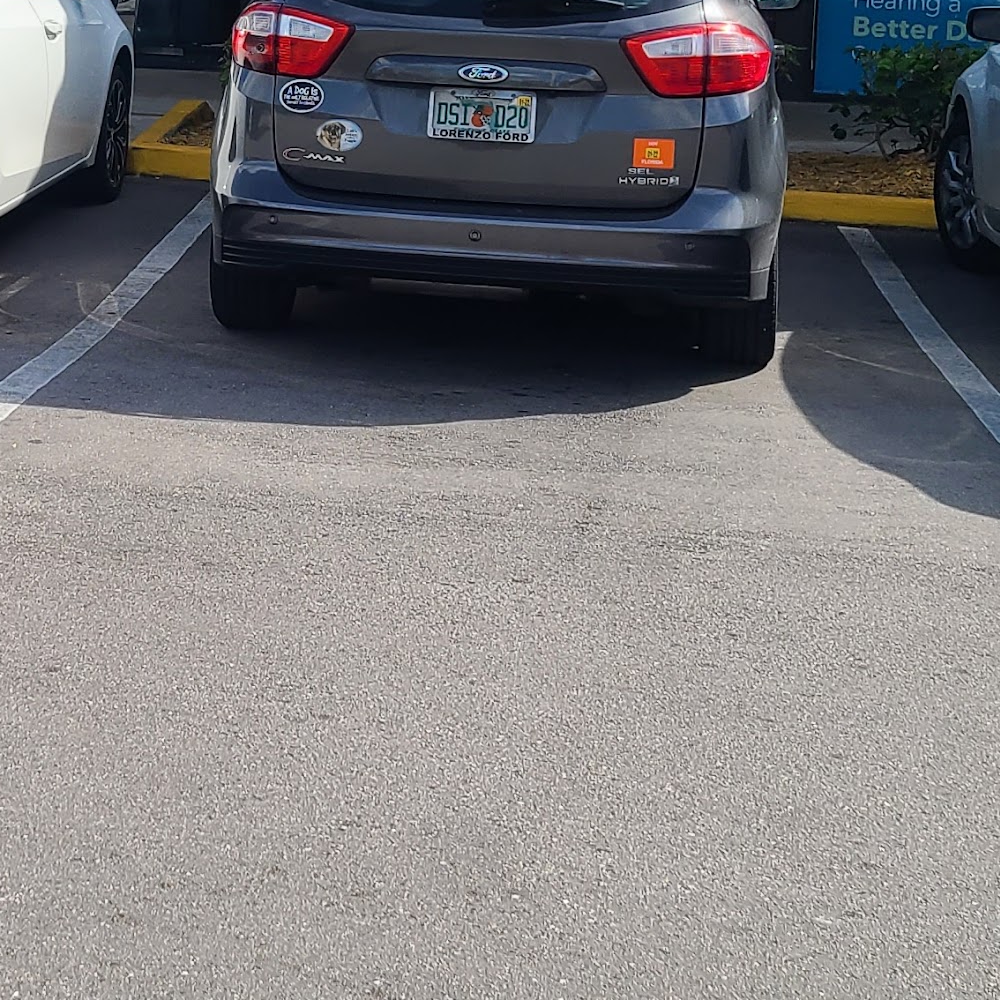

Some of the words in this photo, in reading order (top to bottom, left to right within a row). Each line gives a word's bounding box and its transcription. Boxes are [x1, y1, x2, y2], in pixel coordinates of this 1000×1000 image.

[948, 0, 961, 13] a
[853, 16, 938, 40] Better
[468, 67, 497, 80] Ford
[432, 129, 491, 140] LORENZO
[495, 132, 529, 142] FORD
[627, 167, 655, 175] SEL
[618, 176, 669, 186] HYBRID
